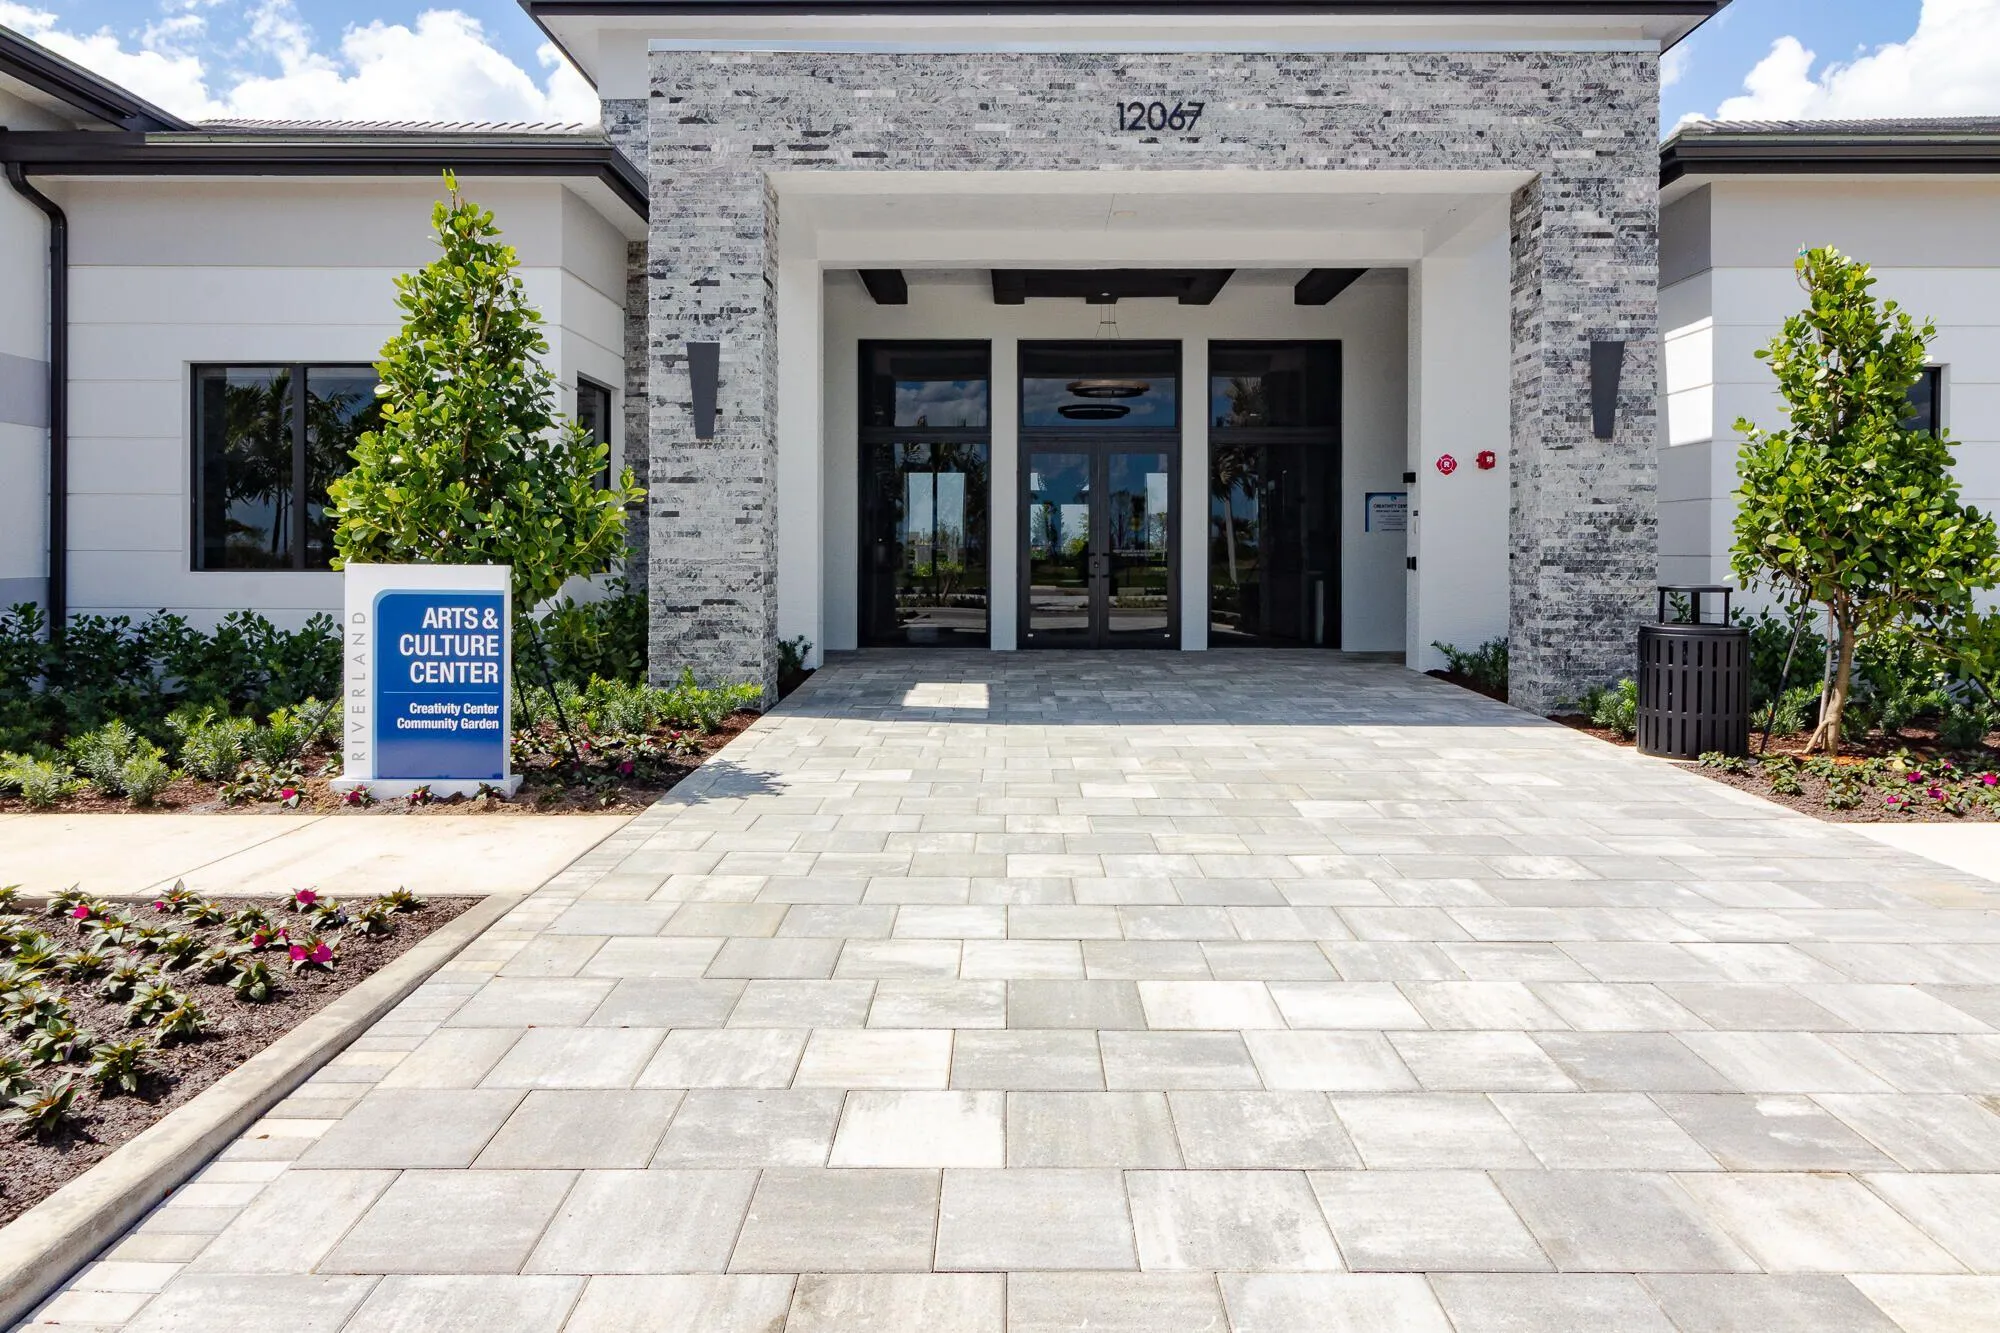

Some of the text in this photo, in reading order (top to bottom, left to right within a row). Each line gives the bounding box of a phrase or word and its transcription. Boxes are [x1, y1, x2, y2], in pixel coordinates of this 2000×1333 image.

[1116, 101, 1205, 131] 12067
[422, 607, 499, 629] ARTS &
[400, 634, 499, 657] CULTURE
[410, 662, 498, 684] CENTER
[351, 612, 366, 761] RIVERLAND
[409, 702, 499, 716] Creativity Center
[397, 718, 499, 731] Community Garden
